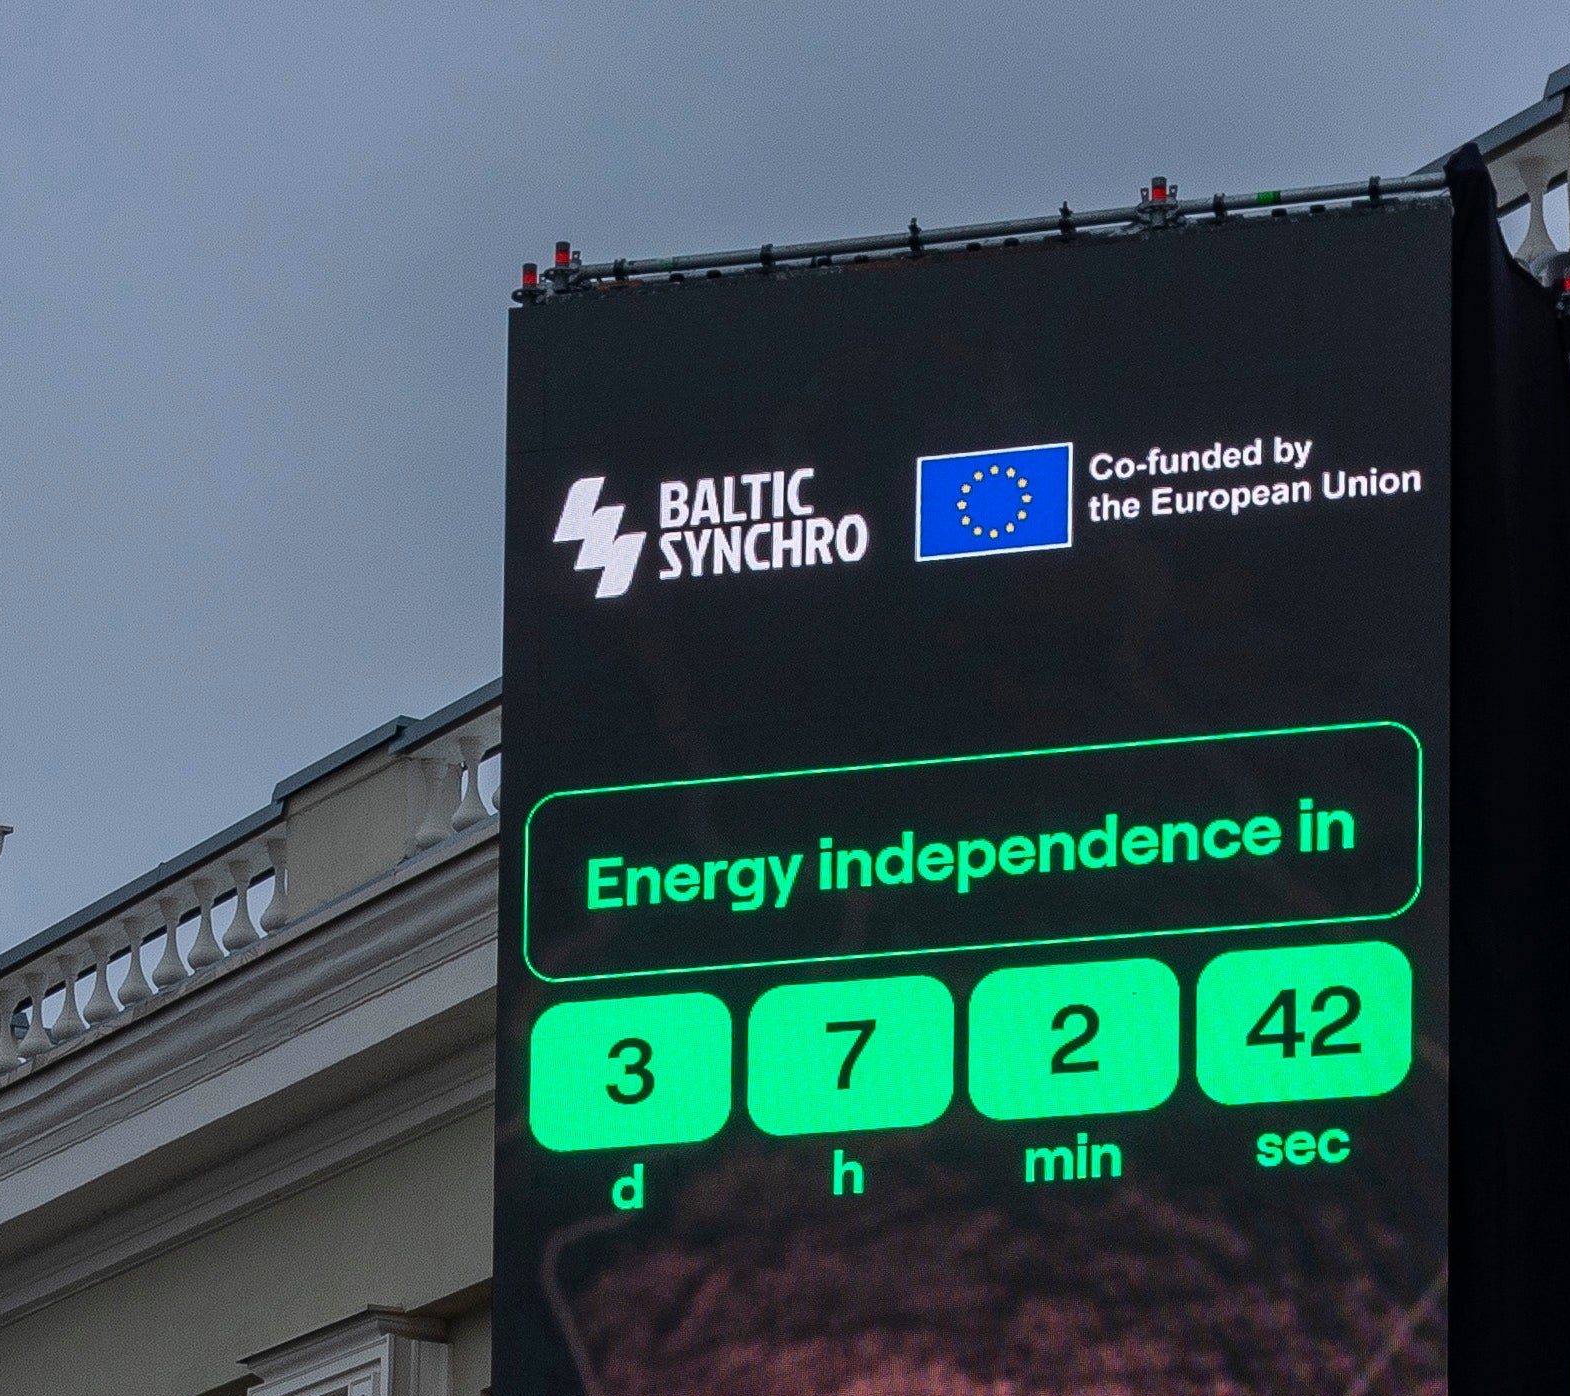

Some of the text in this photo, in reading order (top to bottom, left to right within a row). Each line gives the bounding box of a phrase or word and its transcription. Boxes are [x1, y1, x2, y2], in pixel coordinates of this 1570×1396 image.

[1089, 437, 1313, 481] Co-funded by
[659, 467, 816, 528] BALTIC
[1088, 467, 1422, 521] the European Union
[659, 513, 868, 580] SYNCHRO
[586, 797, 1356, 912] Energy independence in
[606, 985, 1363, 1105] 3 7 2 42
[611, 1128, 1351, 1210] d h min sec
